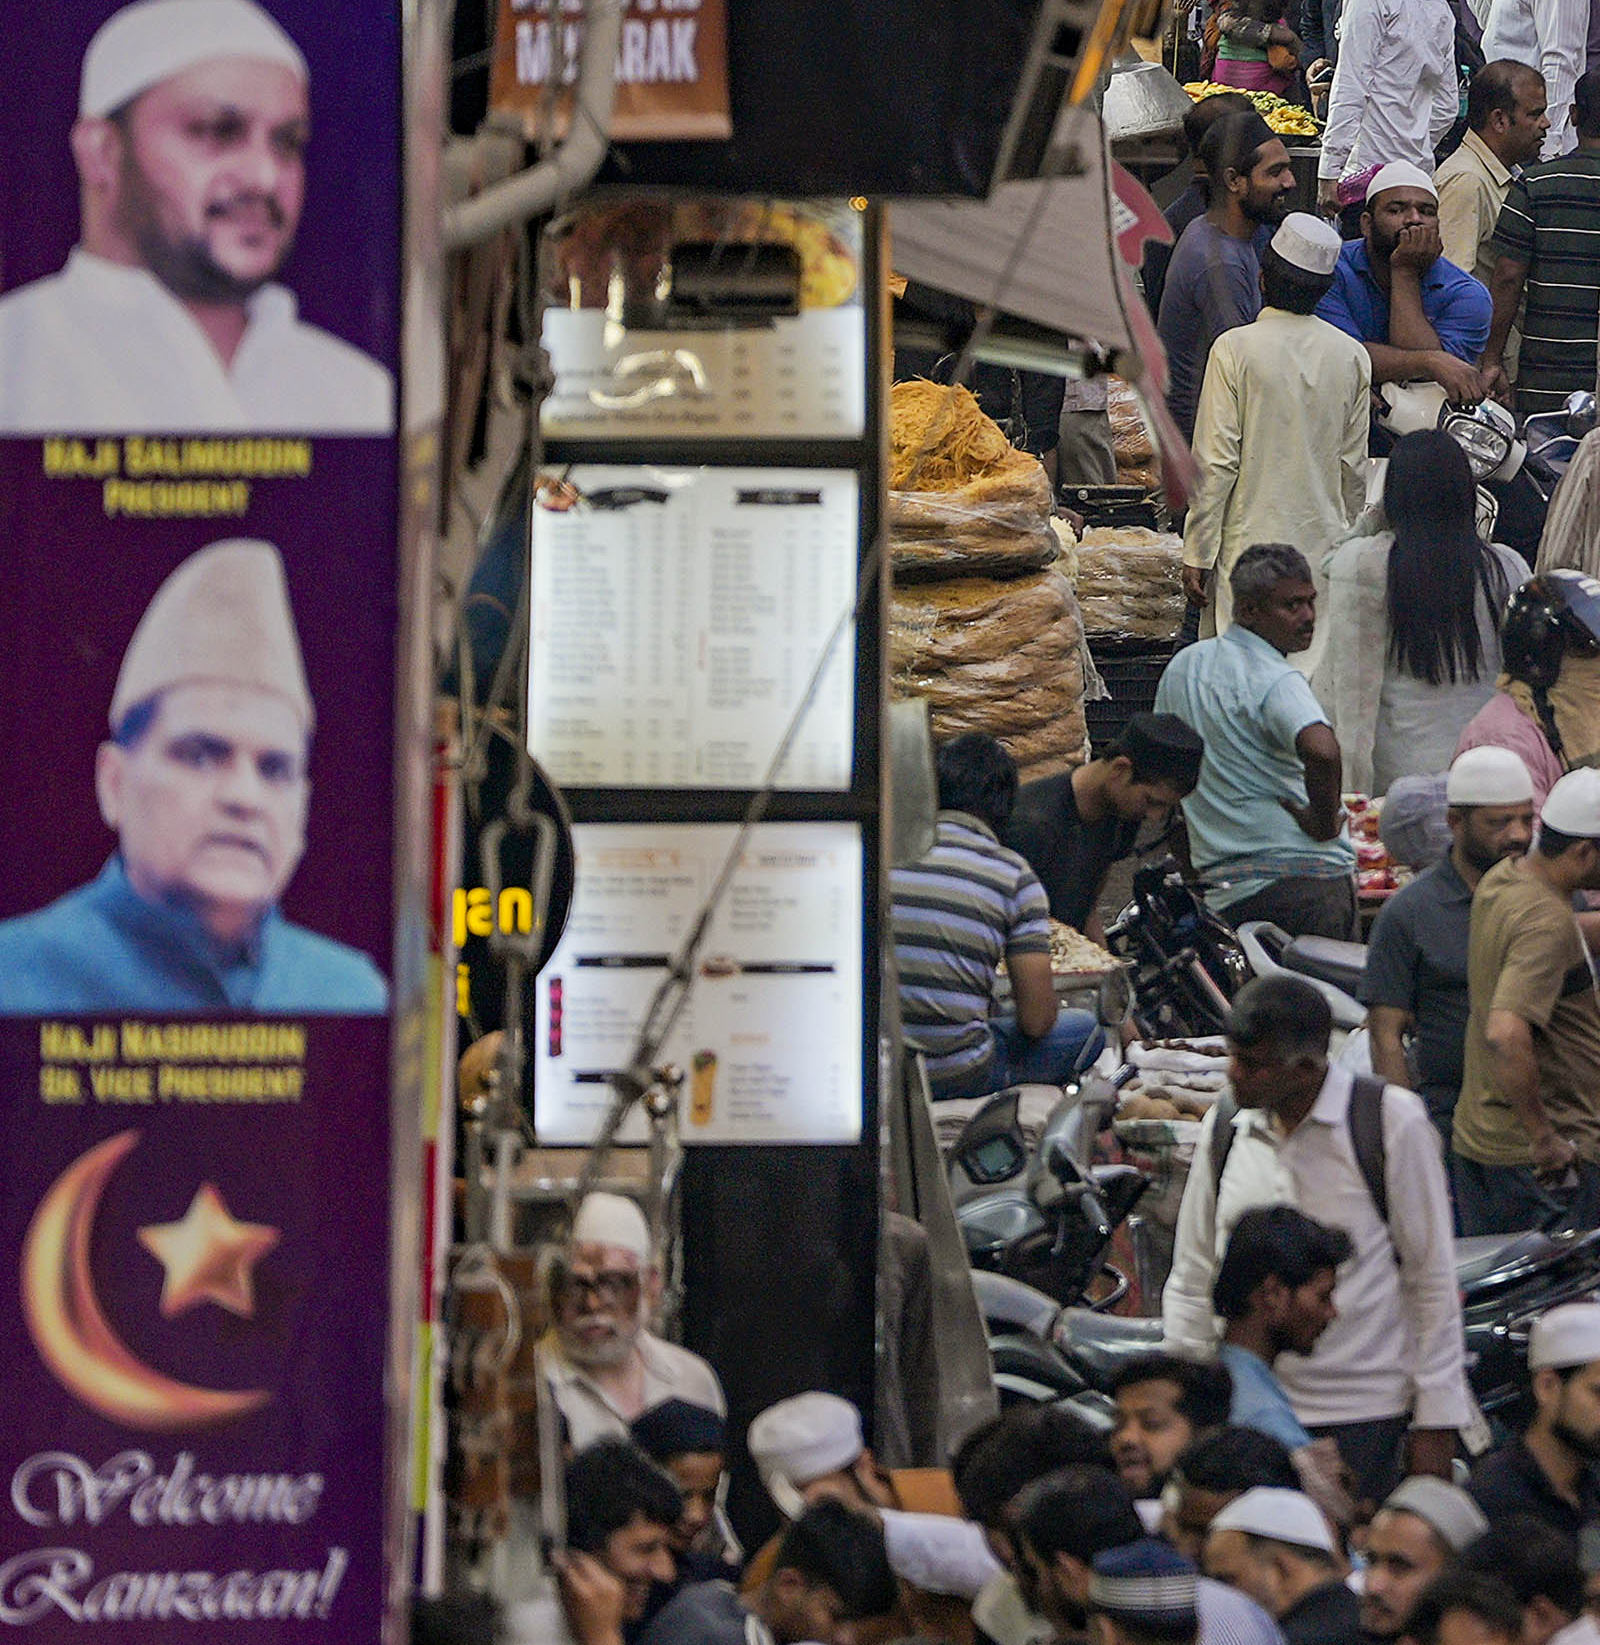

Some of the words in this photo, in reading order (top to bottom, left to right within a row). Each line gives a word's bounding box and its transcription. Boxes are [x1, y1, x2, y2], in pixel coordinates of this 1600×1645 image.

[44, 436, 120, 479] HAJI
[11, 1449, 326, 1527] Welcome
[0, 1545, 350, 1626] Ramzaan!
